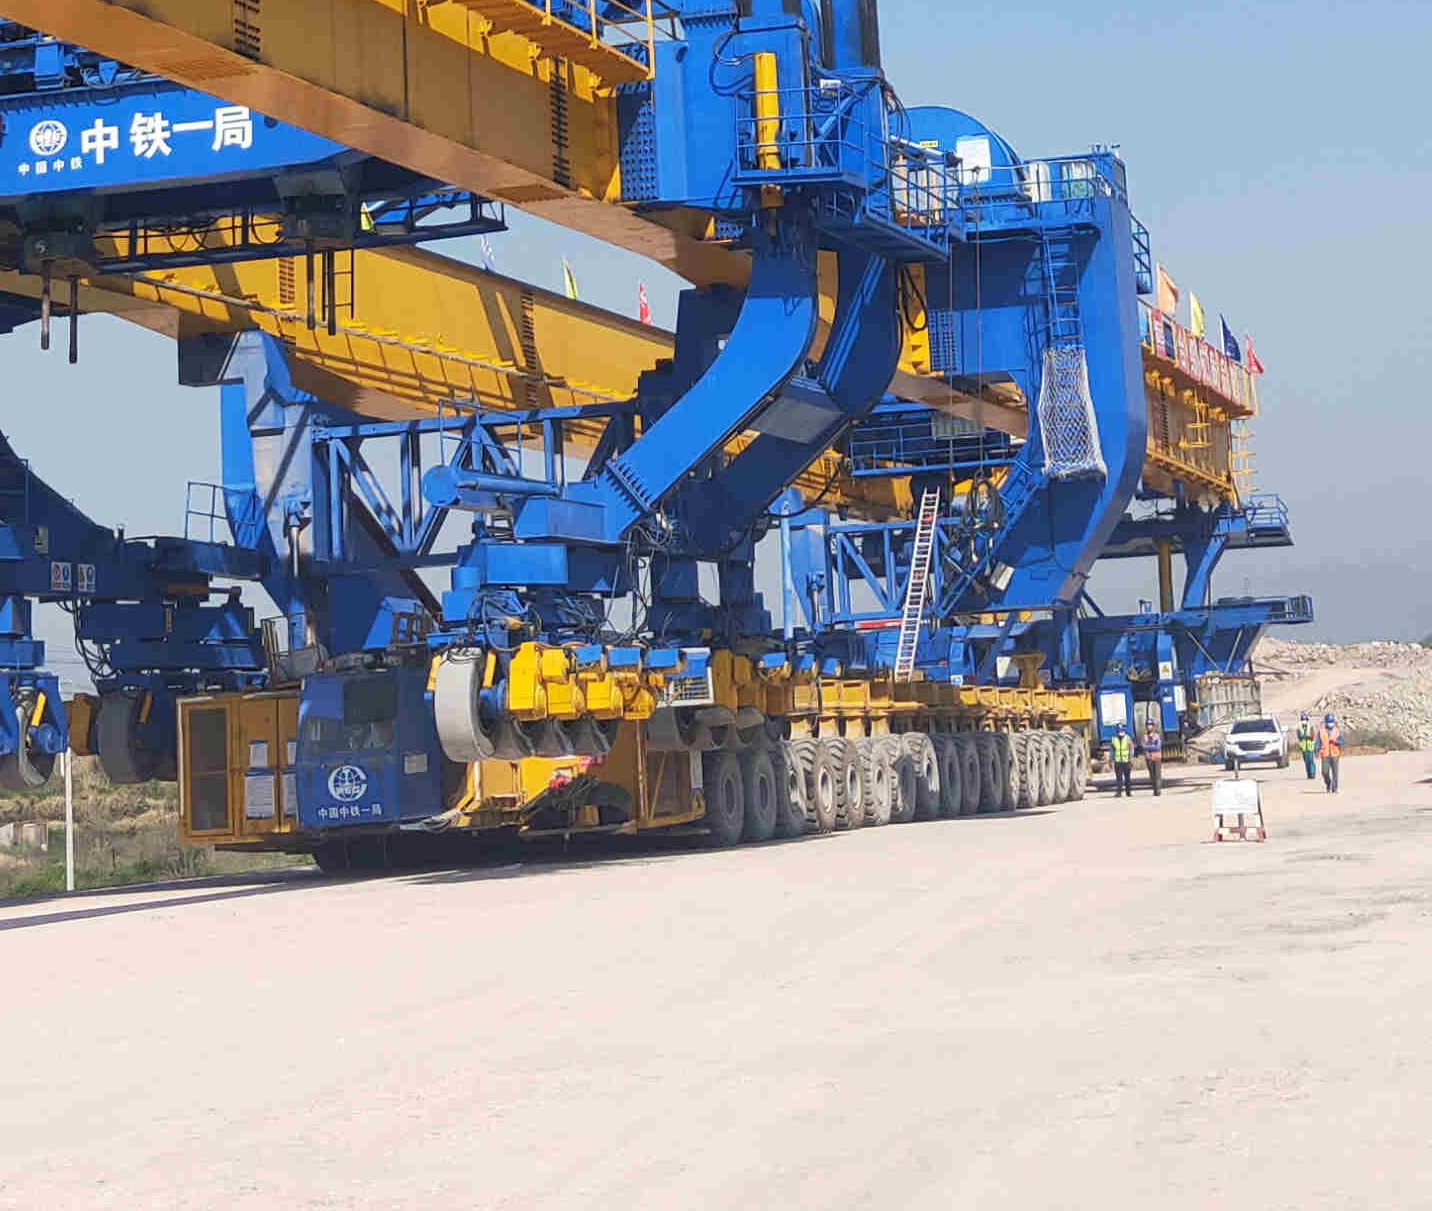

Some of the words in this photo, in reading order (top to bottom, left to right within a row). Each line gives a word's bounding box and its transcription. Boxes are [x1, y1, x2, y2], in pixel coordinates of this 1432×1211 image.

[81, 106, 253, 165] 中铁一局
[17, 156, 83, 177] 中国中铁
[318, 803, 382, 820] 中国中铁一局
